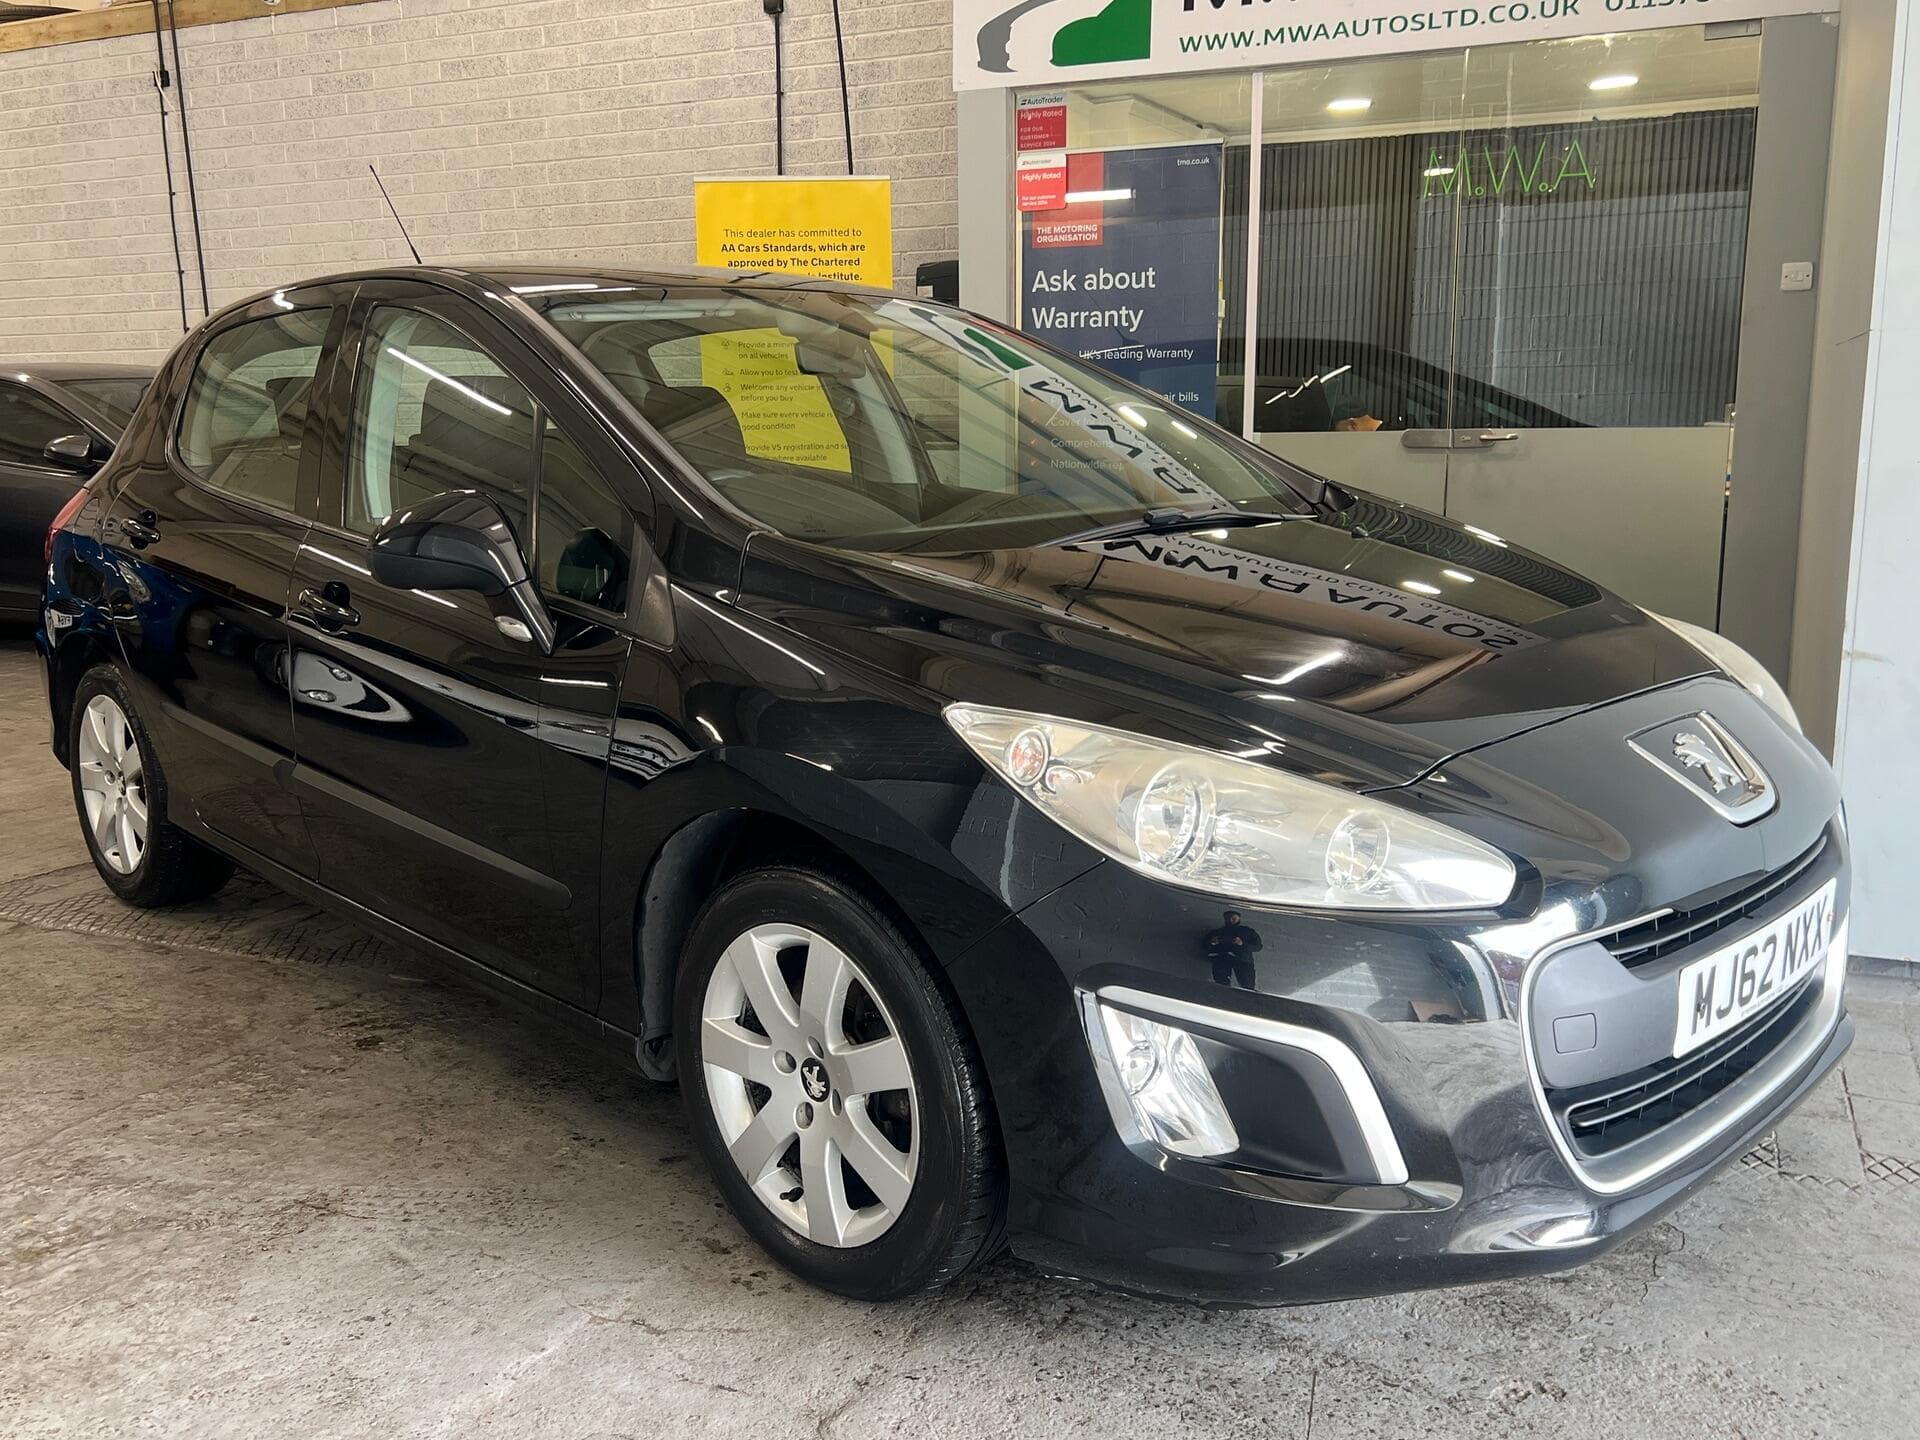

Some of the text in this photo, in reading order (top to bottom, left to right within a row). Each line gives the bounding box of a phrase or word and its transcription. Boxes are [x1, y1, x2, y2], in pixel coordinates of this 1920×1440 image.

[1179, 0, 1580, 53] WWW.MWAAUTOSLTD.CO.UK
[1027, 96, 1063, 105] AutoTrader
[1021, 111, 1041, 120] Highly
[1177, 157, 1210, 166] tmo.co.uk
[1022, 173, 1042, 182] Highly
[725, 228, 862, 238] This dealer has committed to
[1037, 224, 1098, 235] THE MOTORING
[1036, 233, 1098, 243] ORGANISATION
[721, 243, 866, 253] AA Cars Standards, which are
[727, 257, 860, 269] approved by The Chartered
[1032, 267, 1156, 293] Ask about
[1032, 305, 1144, 333] Warranty
[759, 352, 789, 360] vehicles
[1104, 349, 1143, 361] leading
[1146, 348, 1194, 360] Warranty
[761, 369, 773, 377] you
[741, 383, 774, 391] Welcome
[741, 394, 764, 402] before
[780, 394, 794, 402] buy
[1178, 391, 1200, 402] bills
[780, 412, 800, 420] every
[800, 410, 825, 418] vehicle
[742, 422, 796, 431] good condition
[783, 442, 824, 452] registration
[826, 442, 839, 450] and
[795, 454, 828, 462] available
[1691, 895, 1828, 1036] MJ62 NXX
